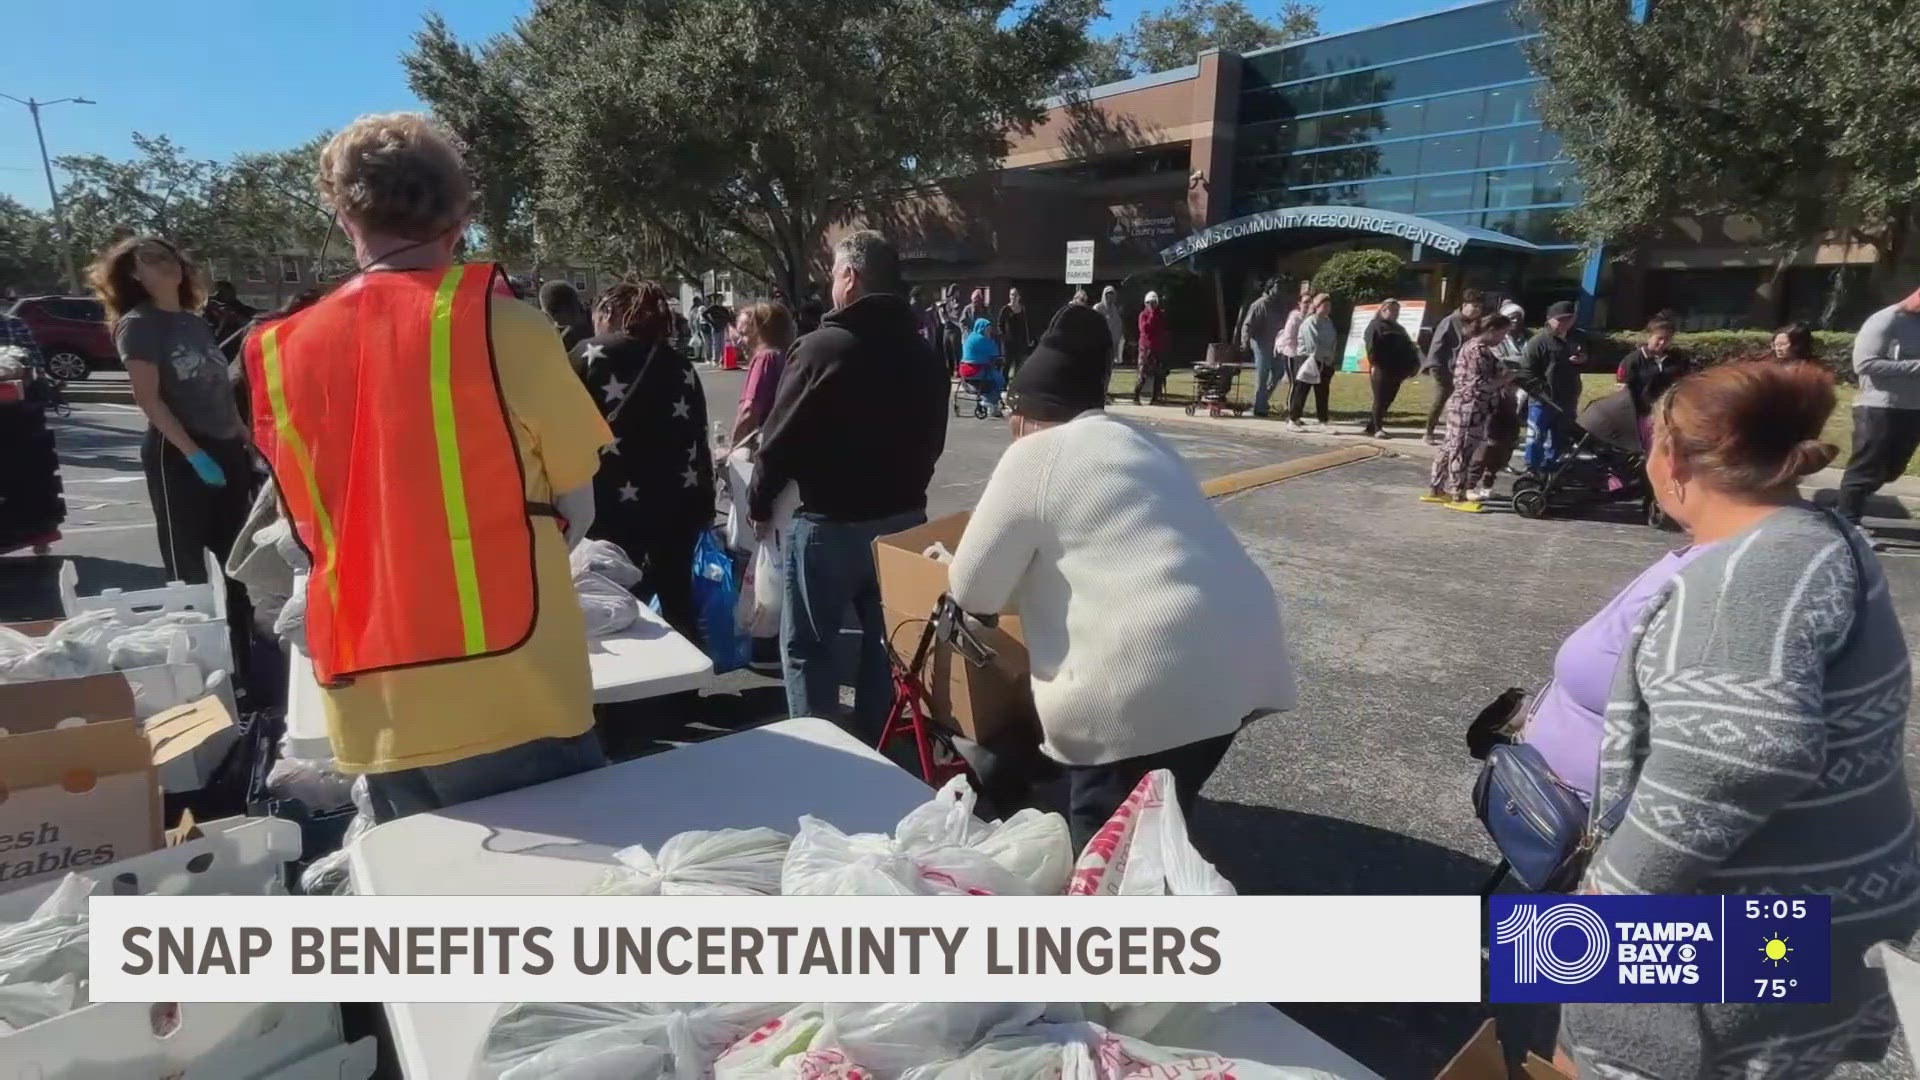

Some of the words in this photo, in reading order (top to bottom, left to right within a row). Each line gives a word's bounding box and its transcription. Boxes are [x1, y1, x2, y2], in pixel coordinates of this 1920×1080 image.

[1186, 230, 1222, 254] DAVIS
[1223, 214, 1305, 240] COMMUNITY
[1308, 212, 1393, 234] RESOURCE
[1394, 222, 1461, 256] CENTER
[1067, 246, 1079, 254] NOT
[1080, 246, 1093, 254] FOR
[1069, 259, 1090, 267] PUBLIC
[1066, 271, 1092, 279] PARKING
